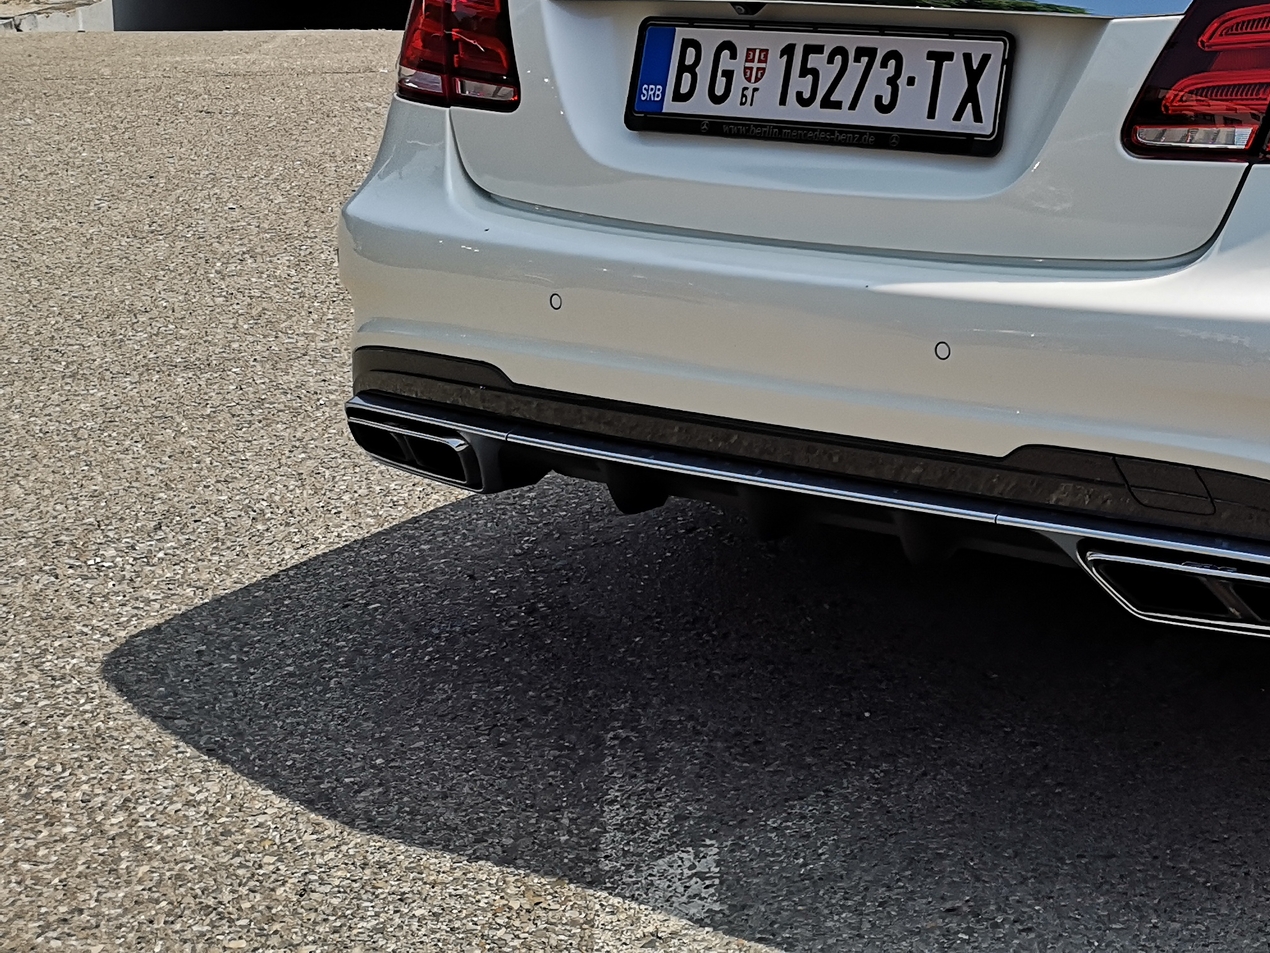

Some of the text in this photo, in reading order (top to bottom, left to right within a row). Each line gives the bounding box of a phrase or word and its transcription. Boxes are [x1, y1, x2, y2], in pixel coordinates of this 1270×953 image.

[671, 37, 738, 105] BG
[640, 84, 663, 102] SRB
[722, 124, 876, 146] www.berlin.mercedes-benz.de
